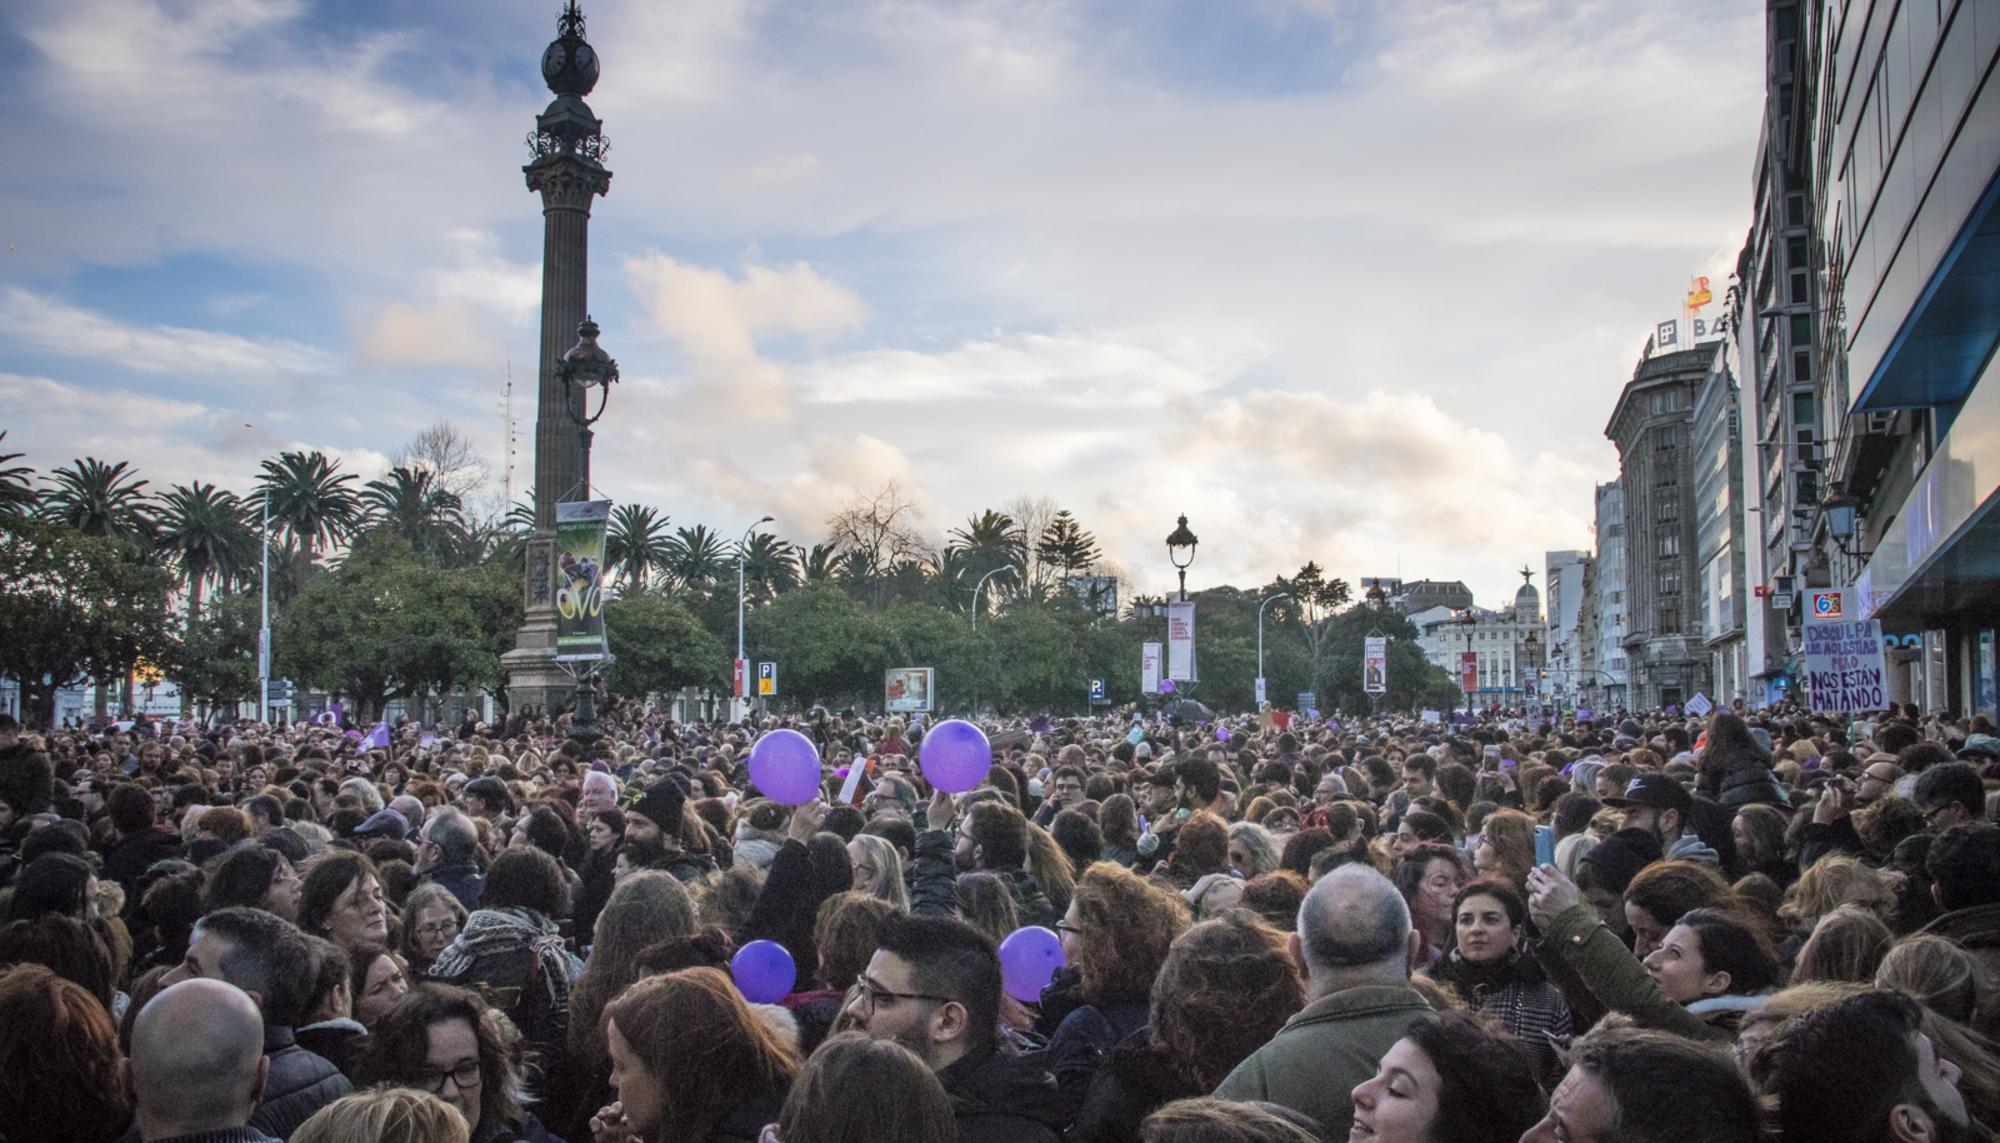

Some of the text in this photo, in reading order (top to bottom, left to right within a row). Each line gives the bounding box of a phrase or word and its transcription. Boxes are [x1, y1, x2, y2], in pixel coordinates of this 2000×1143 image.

[556, 575, 602, 621] OVO
[763, 665, 770, 677] P
[1810, 664, 1881, 690] NOS ESTÁN
[1812, 687, 1882, 711] MATANDO
